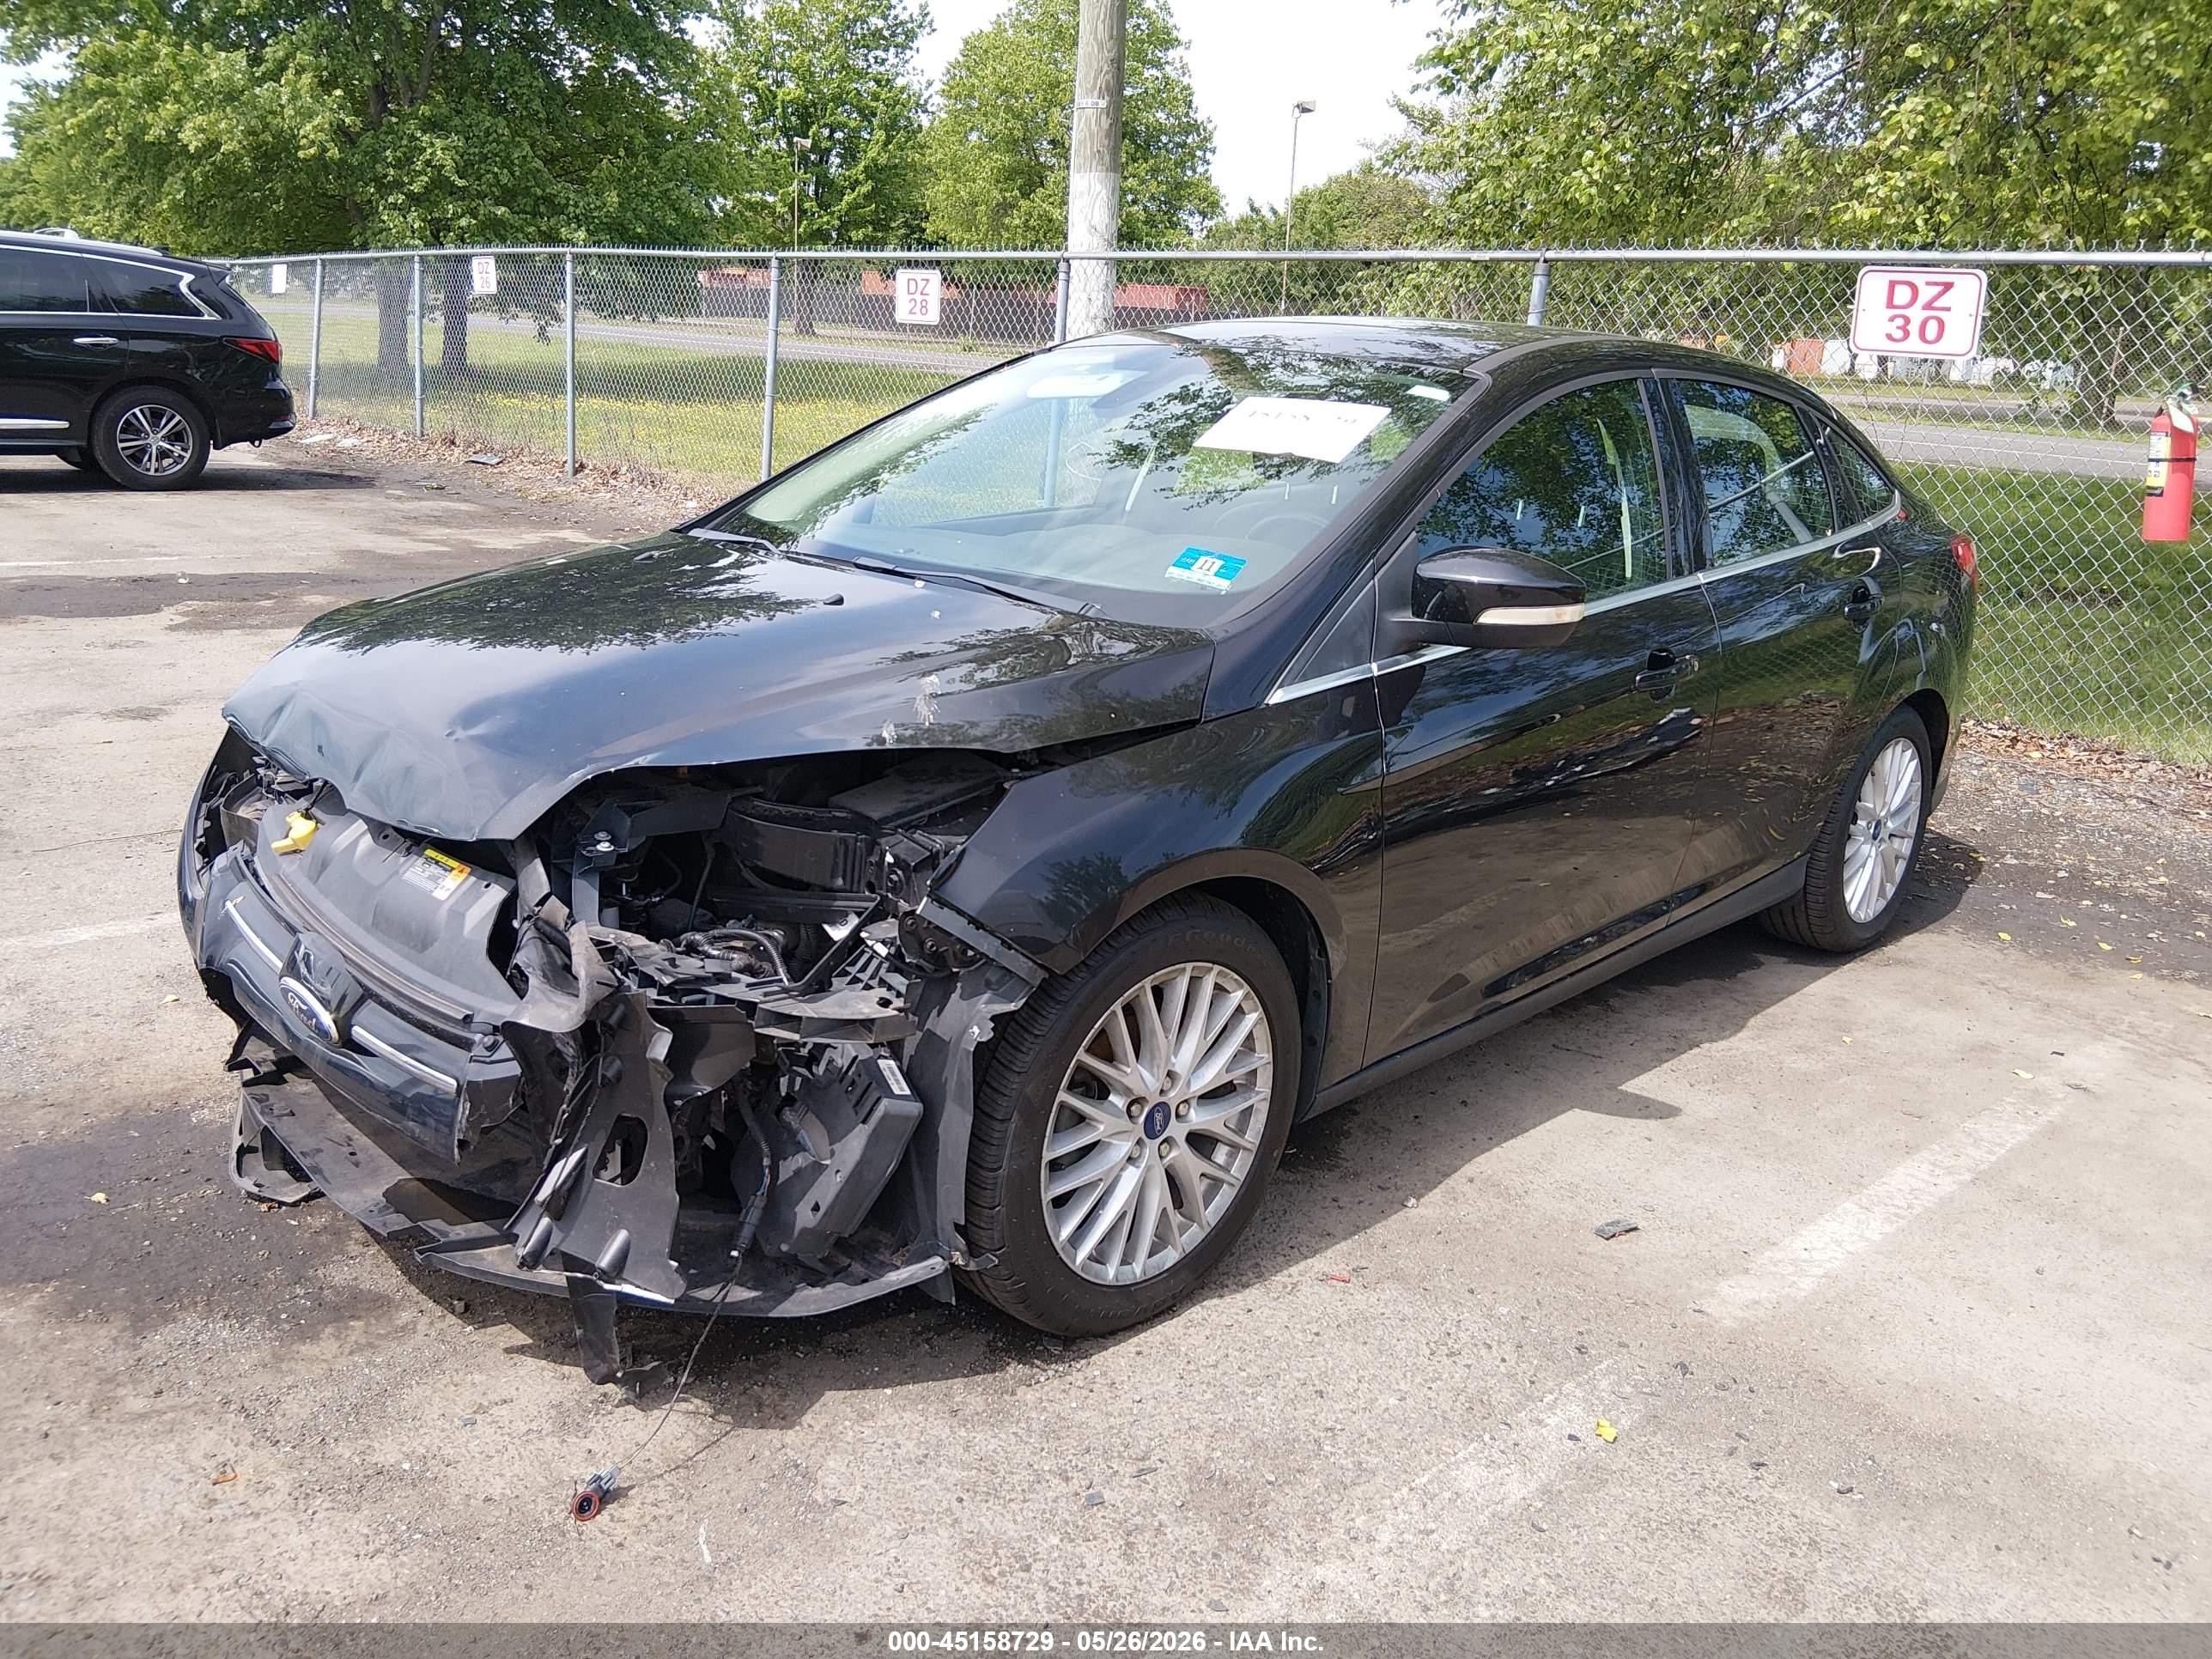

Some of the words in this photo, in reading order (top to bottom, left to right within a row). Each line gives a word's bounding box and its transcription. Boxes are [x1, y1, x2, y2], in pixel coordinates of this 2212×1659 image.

[477, 261, 491, 274] DZ
[907, 277, 930, 296] DZ
[1885, 279, 1955, 312] DZ
[908, 298, 928, 315] 28
[1885, 313, 1946, 344] 30
[287, 991, 319, 1035] Ford
